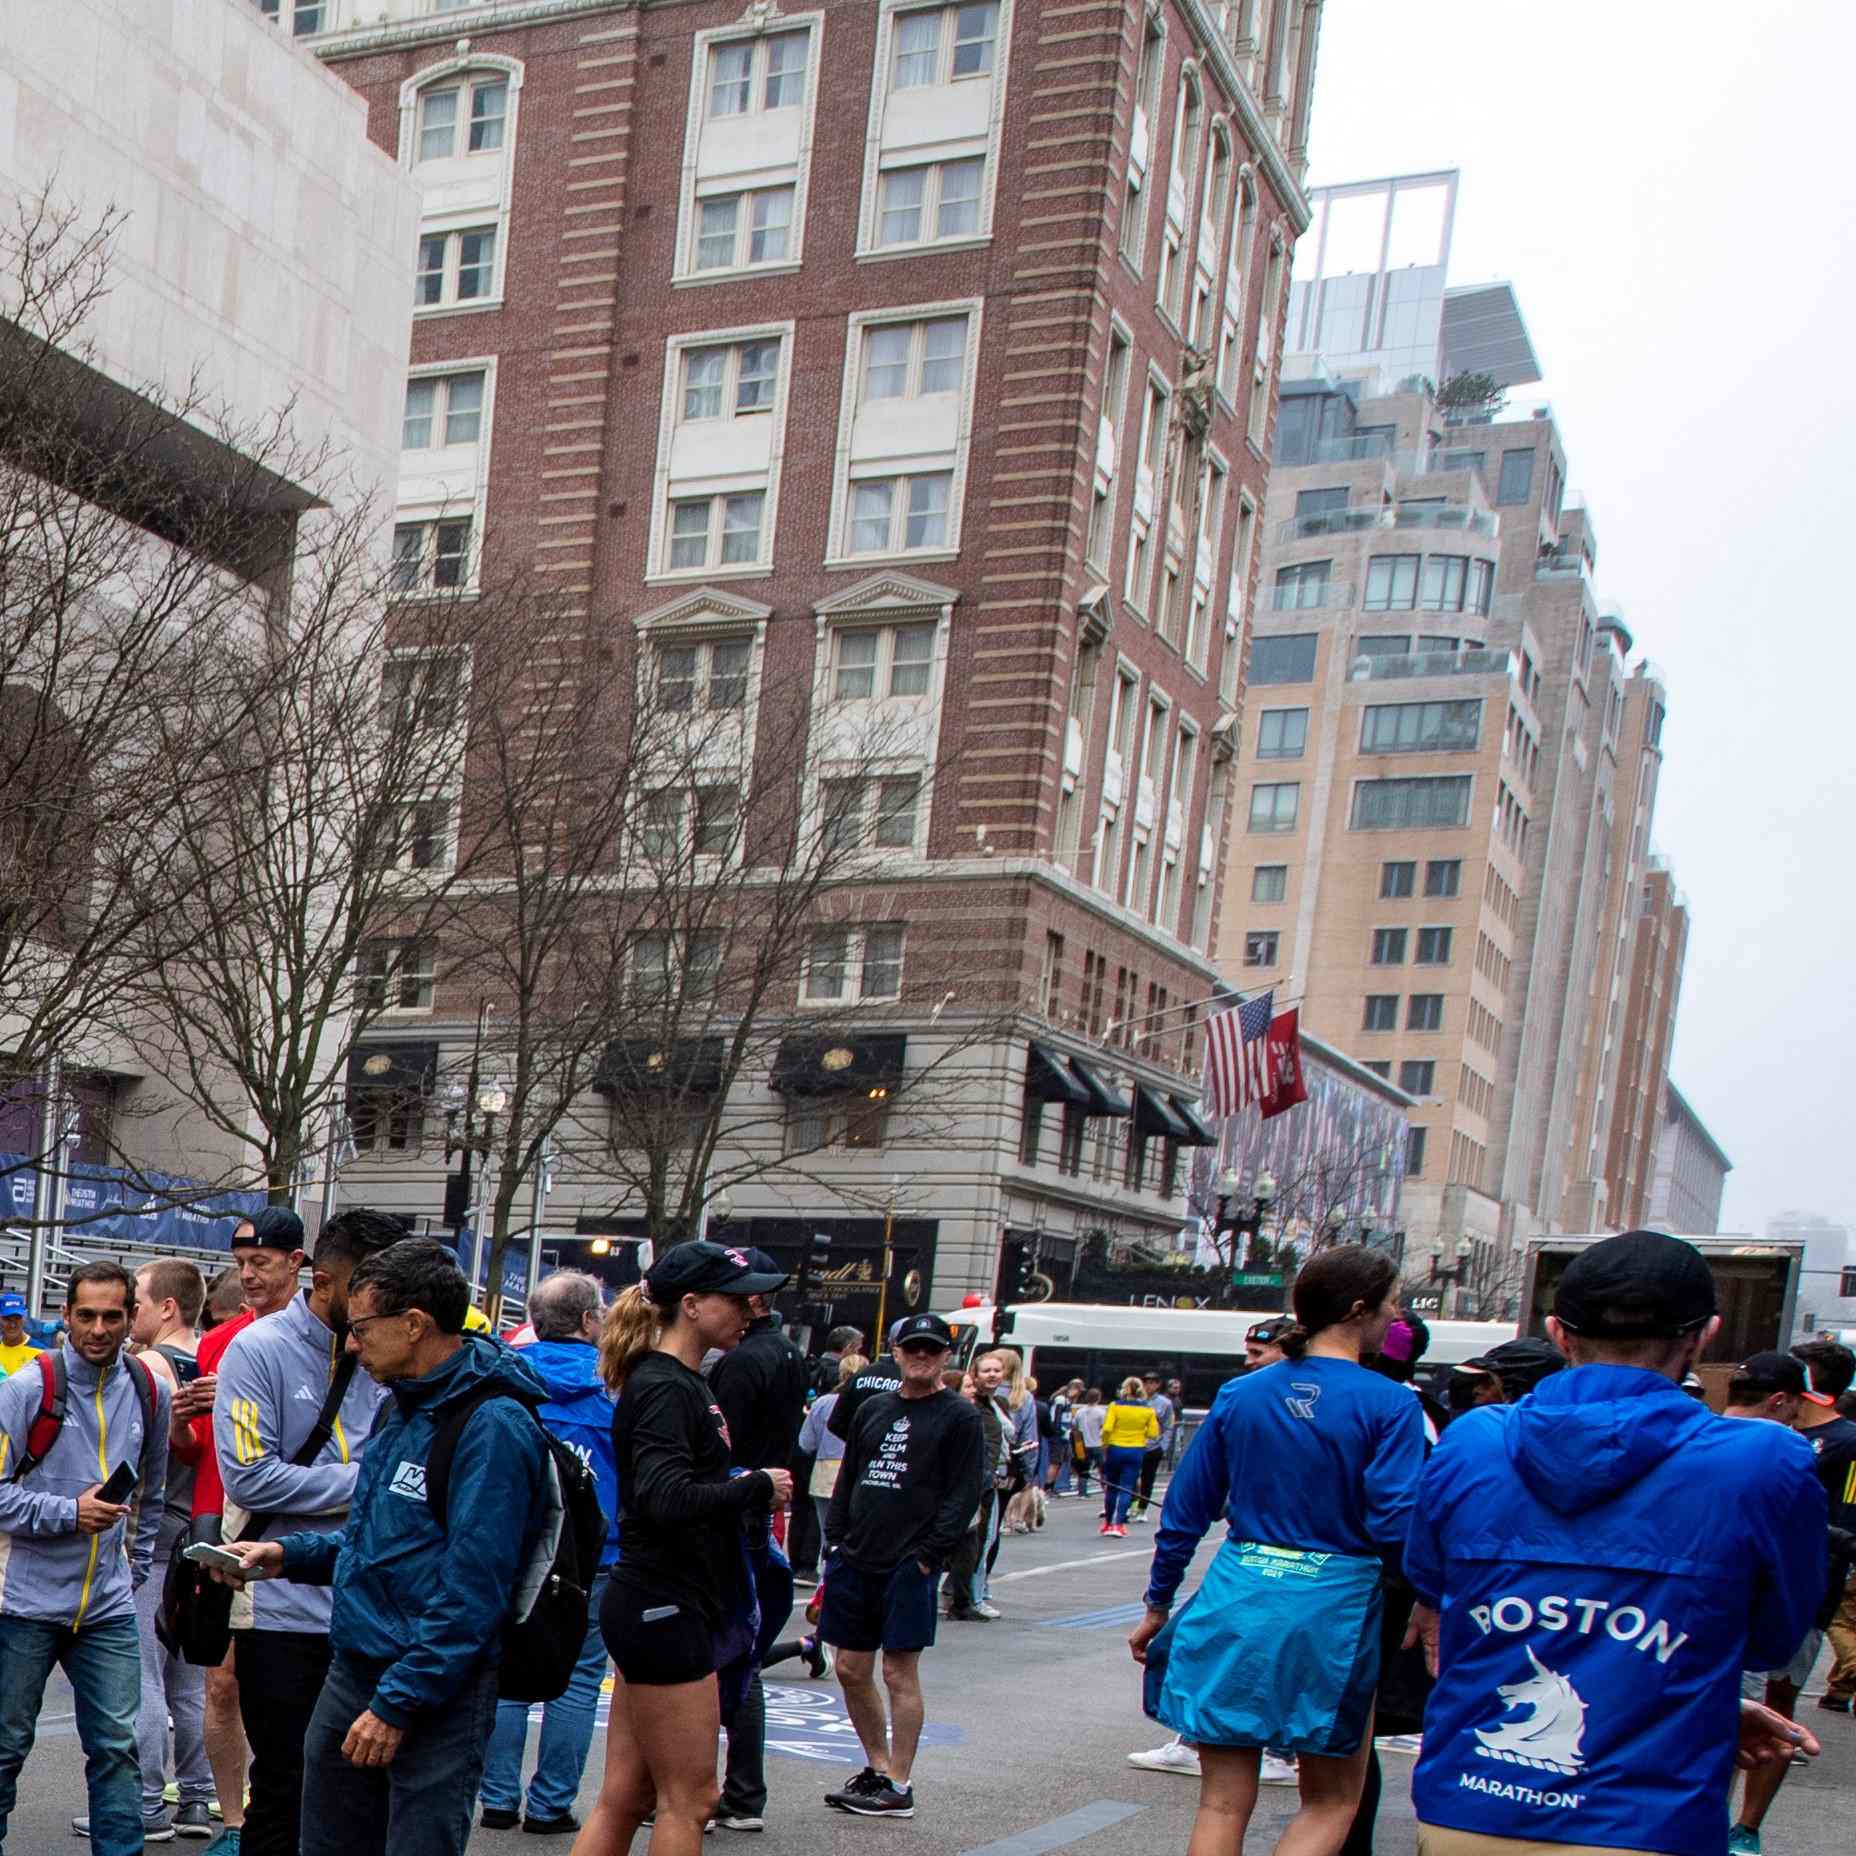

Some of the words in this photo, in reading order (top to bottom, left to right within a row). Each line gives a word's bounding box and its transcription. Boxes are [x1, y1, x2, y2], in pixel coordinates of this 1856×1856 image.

[885, 1432, 909, 1443] KEEP
[886, 1460, 908, 1472] THIS
[868, 1469, 898, 1481] TOWN
[1469, 1594, 1689, 1665] BOSTON
[1458, 1772, 1581, 1809] MARATHON
